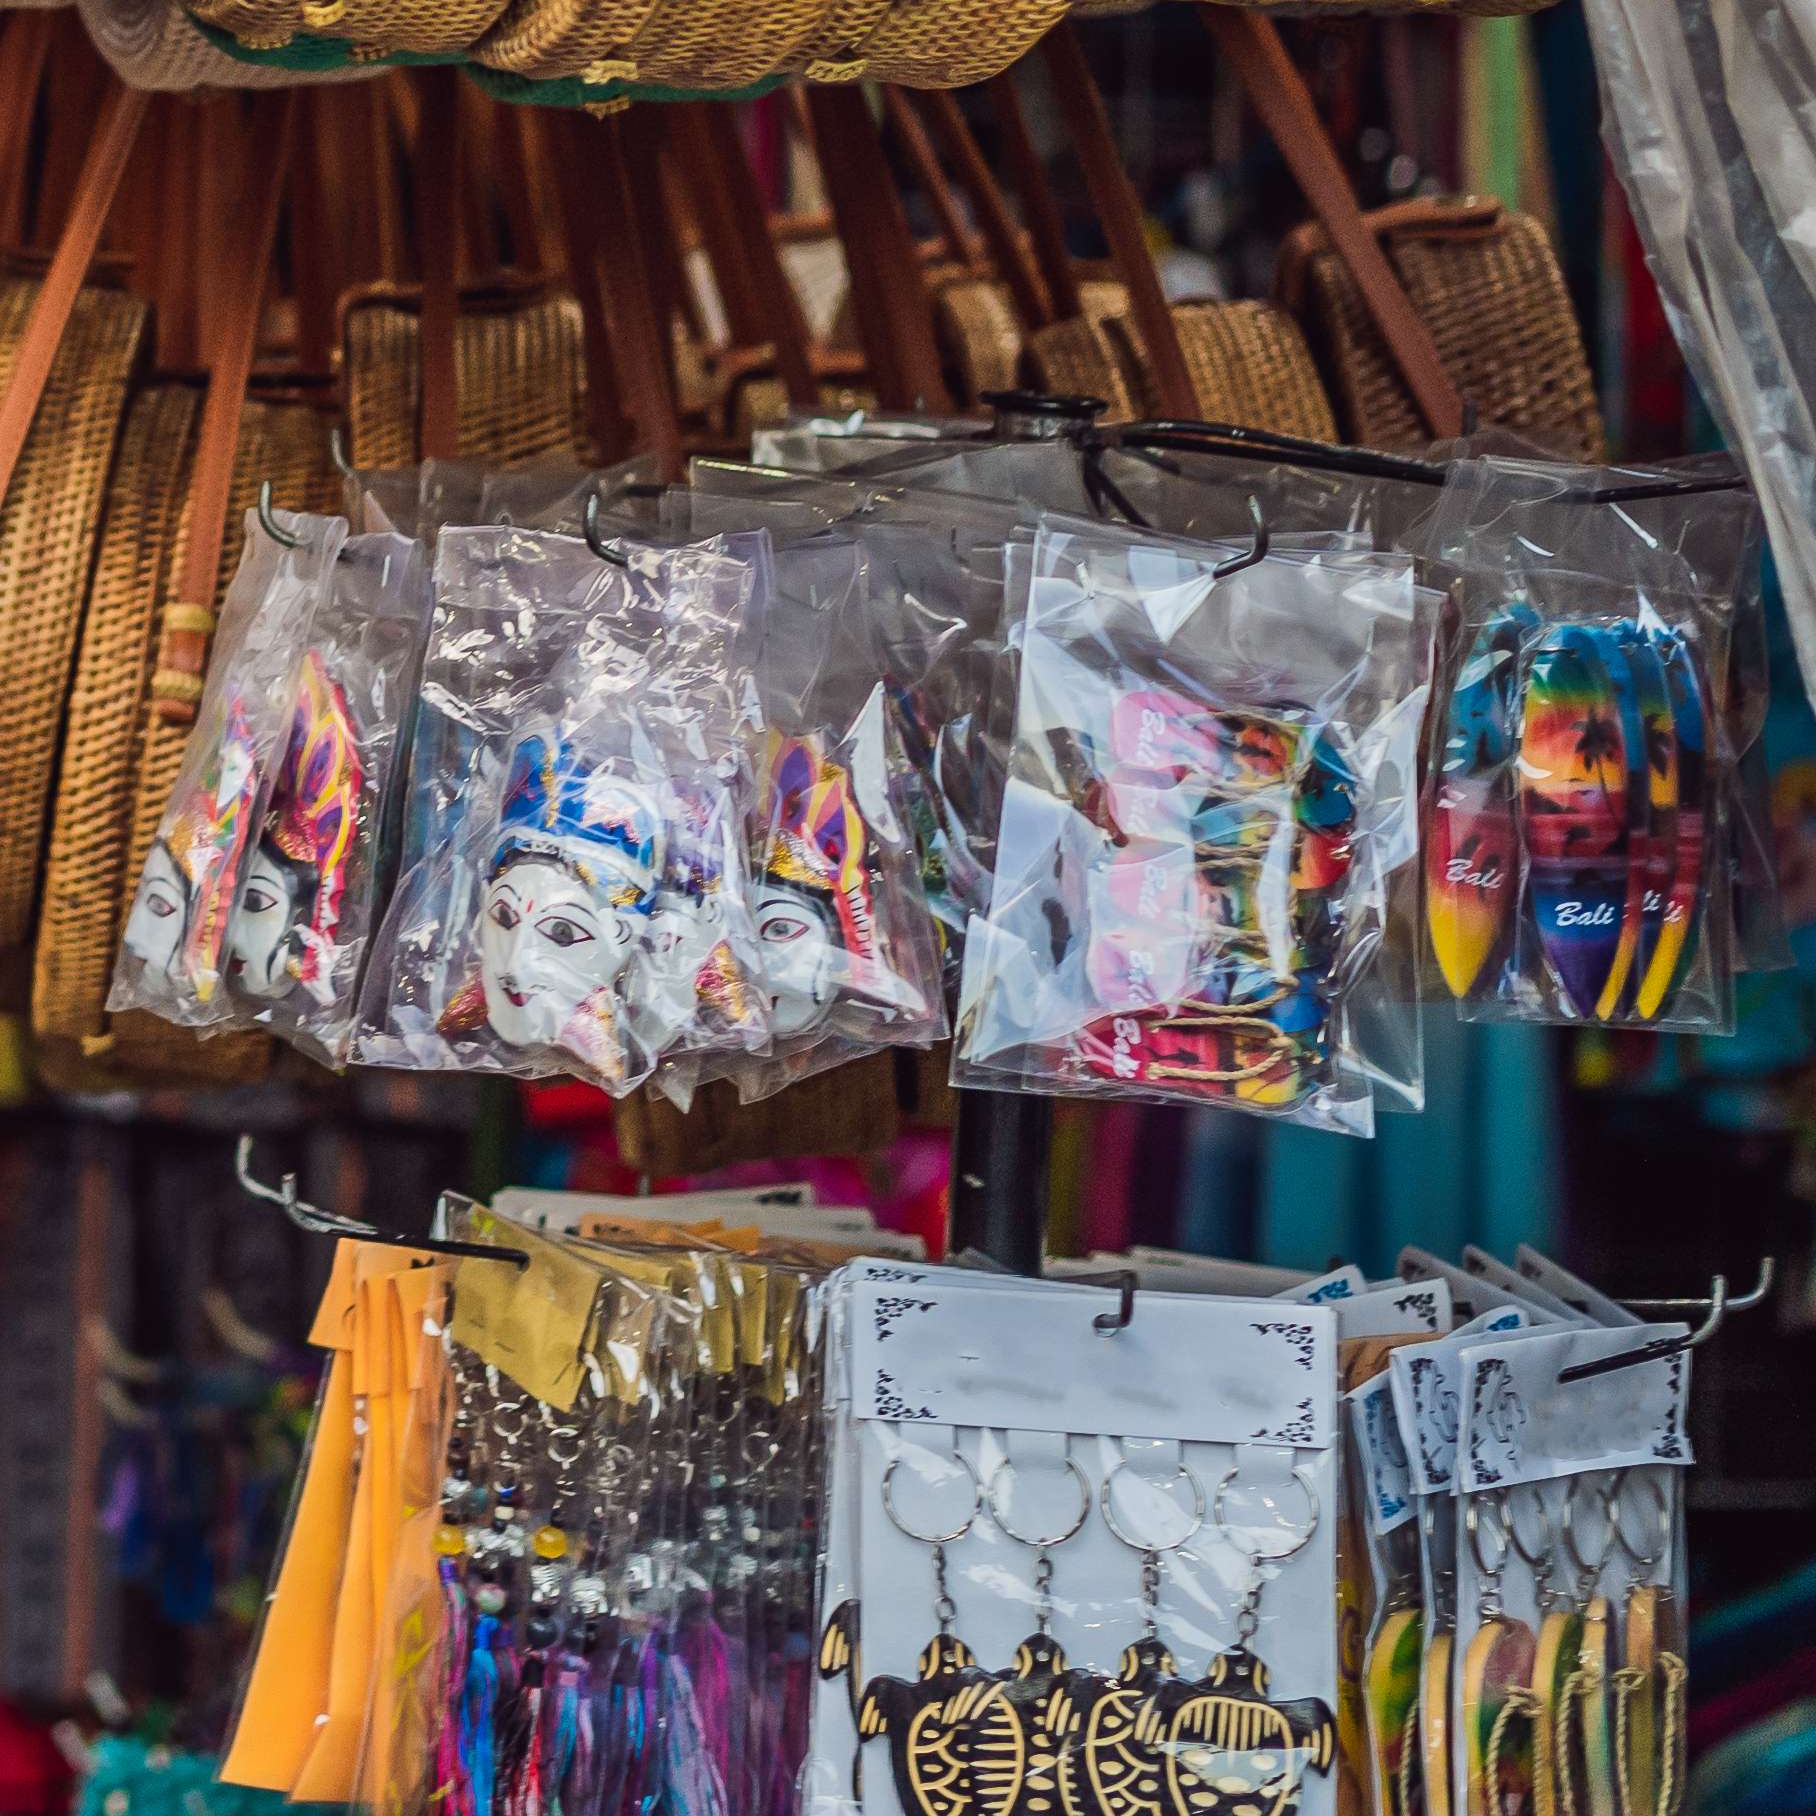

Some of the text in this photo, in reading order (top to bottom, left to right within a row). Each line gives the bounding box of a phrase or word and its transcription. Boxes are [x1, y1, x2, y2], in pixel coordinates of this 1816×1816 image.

[1446, 858, 1504, 888] Bali
[1555, 901, 1615, 926] Bali
[1642, 890, 1662, 912] li
[1663, 900, 1684, 923] li
[1113, 1017, 1142, 1078] Bali
